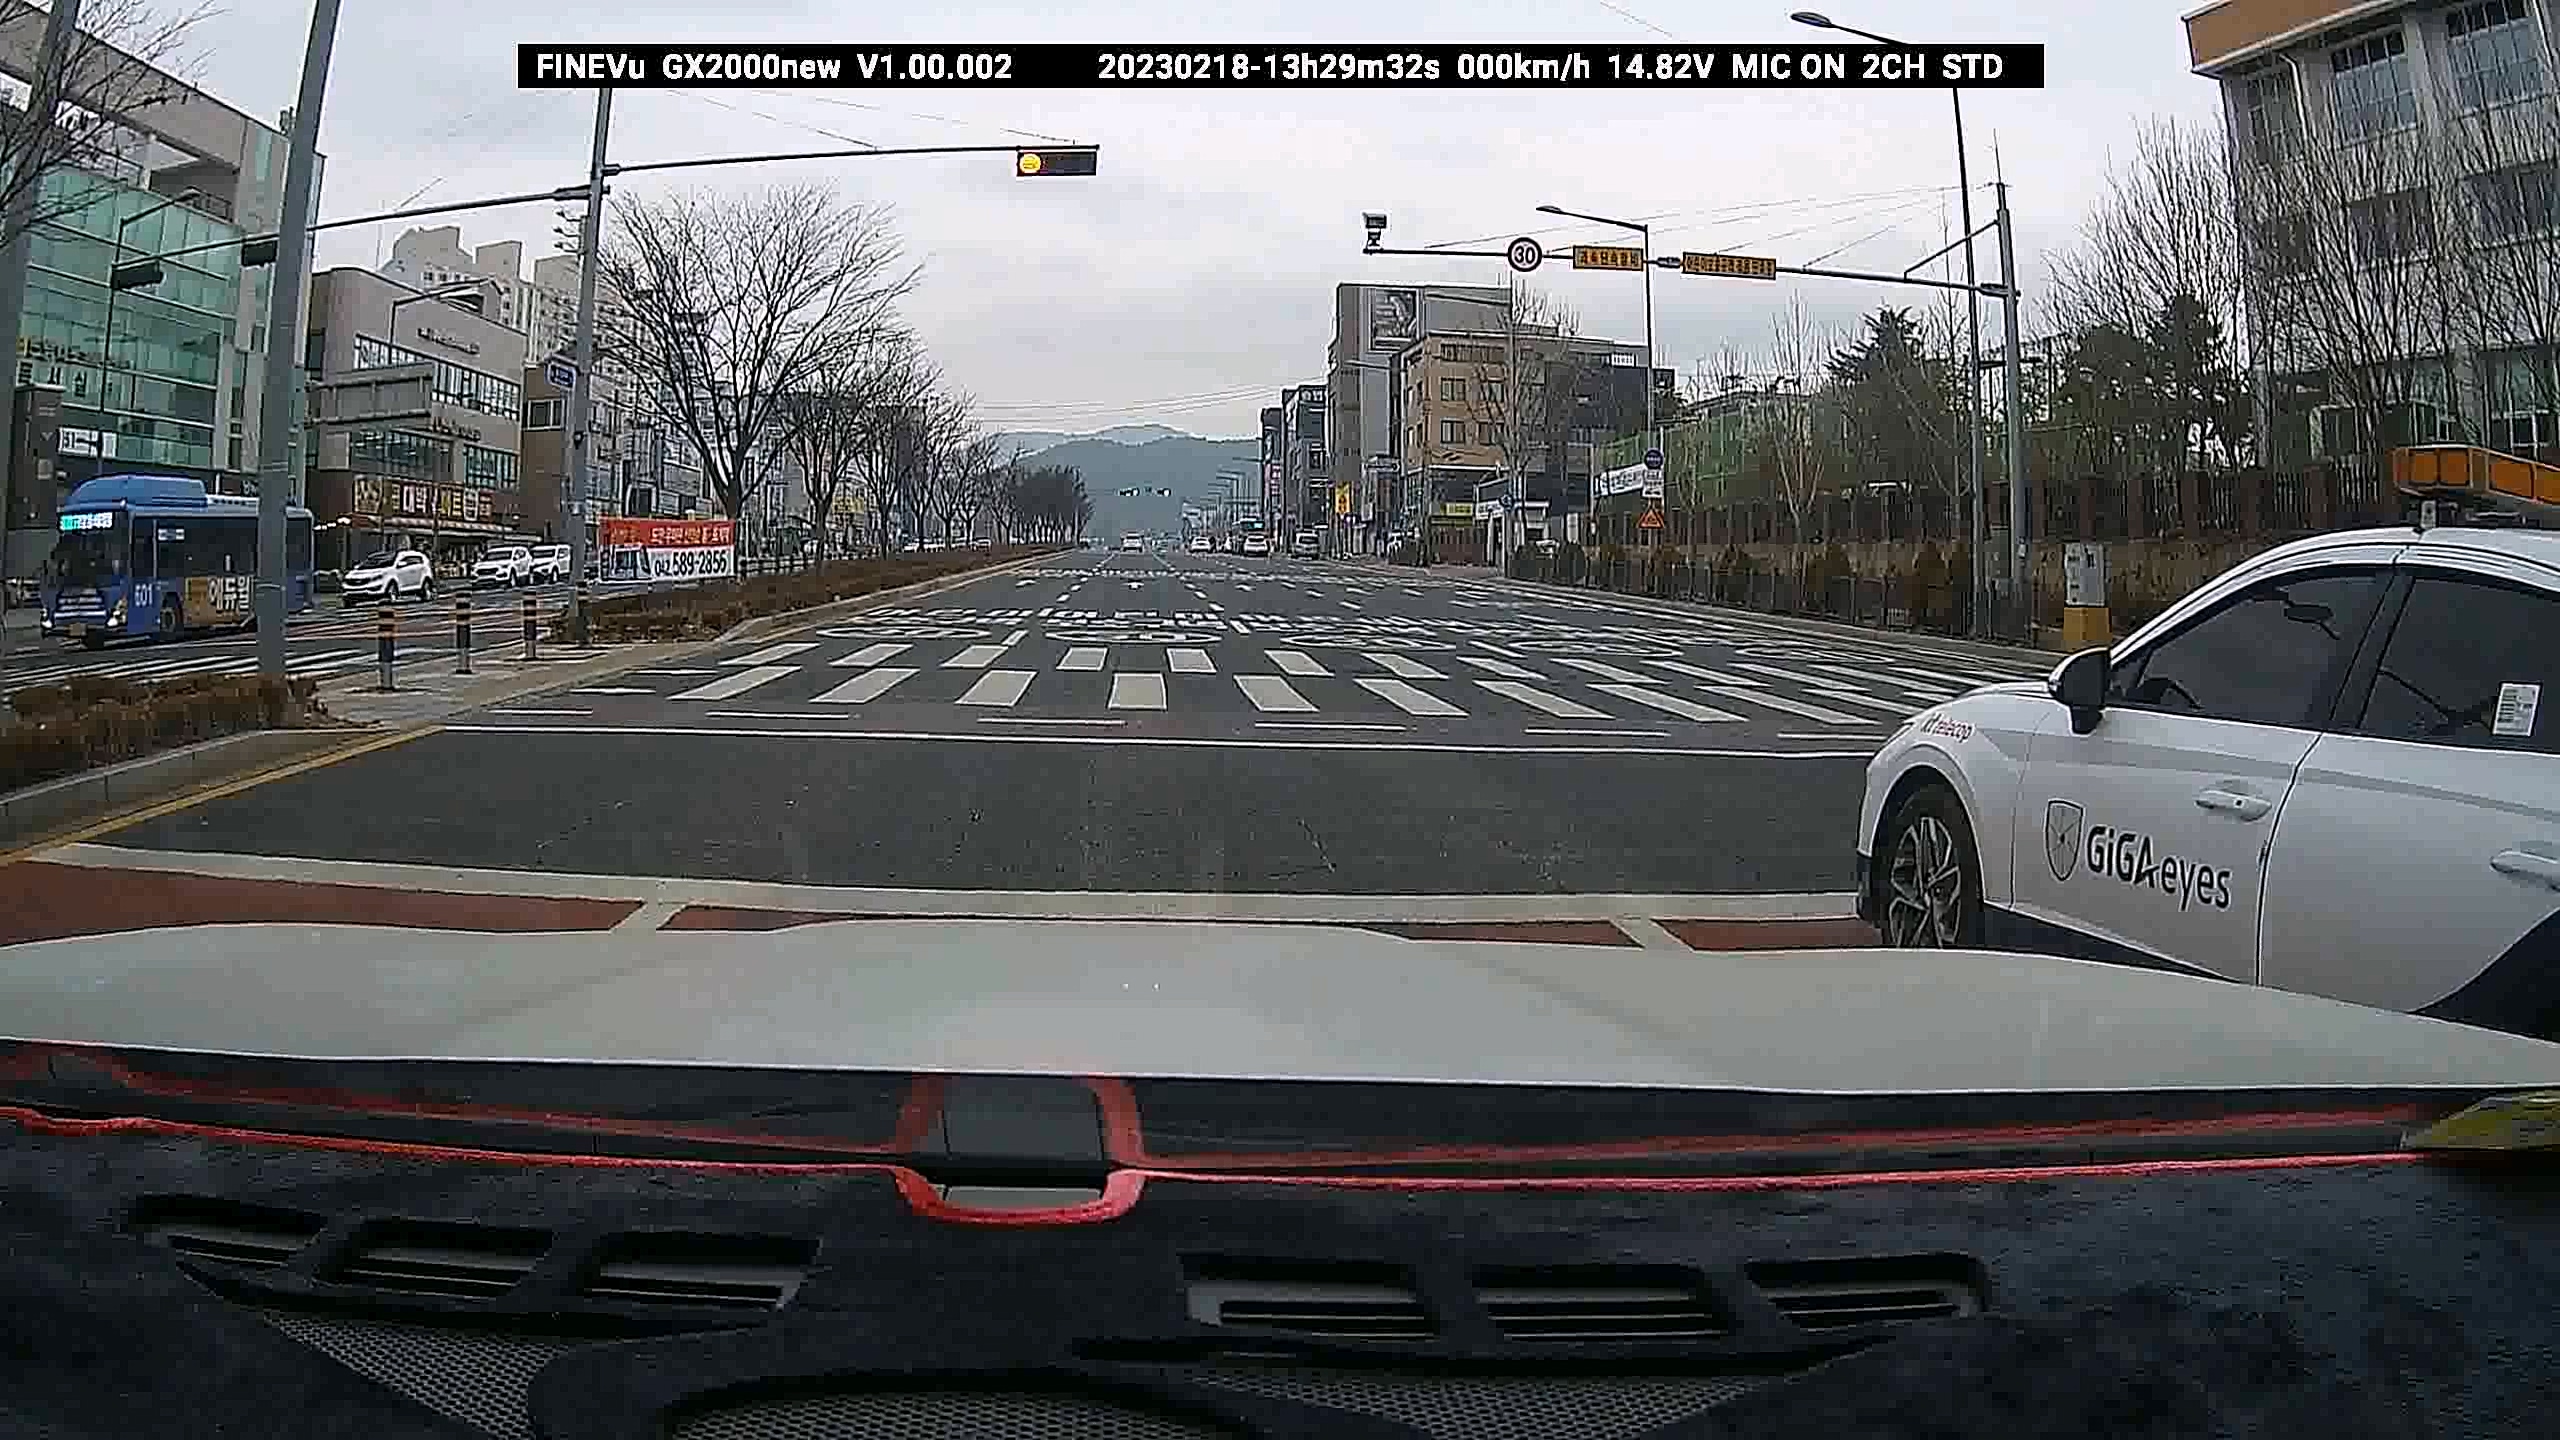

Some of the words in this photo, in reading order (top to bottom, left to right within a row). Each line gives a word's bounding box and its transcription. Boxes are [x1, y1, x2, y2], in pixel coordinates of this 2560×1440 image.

[1514, 245, 1536, 264] 30
[208, 576, 251, 610] 에듀윌
[2086, 825, 2231, 912] GiGAeyes
